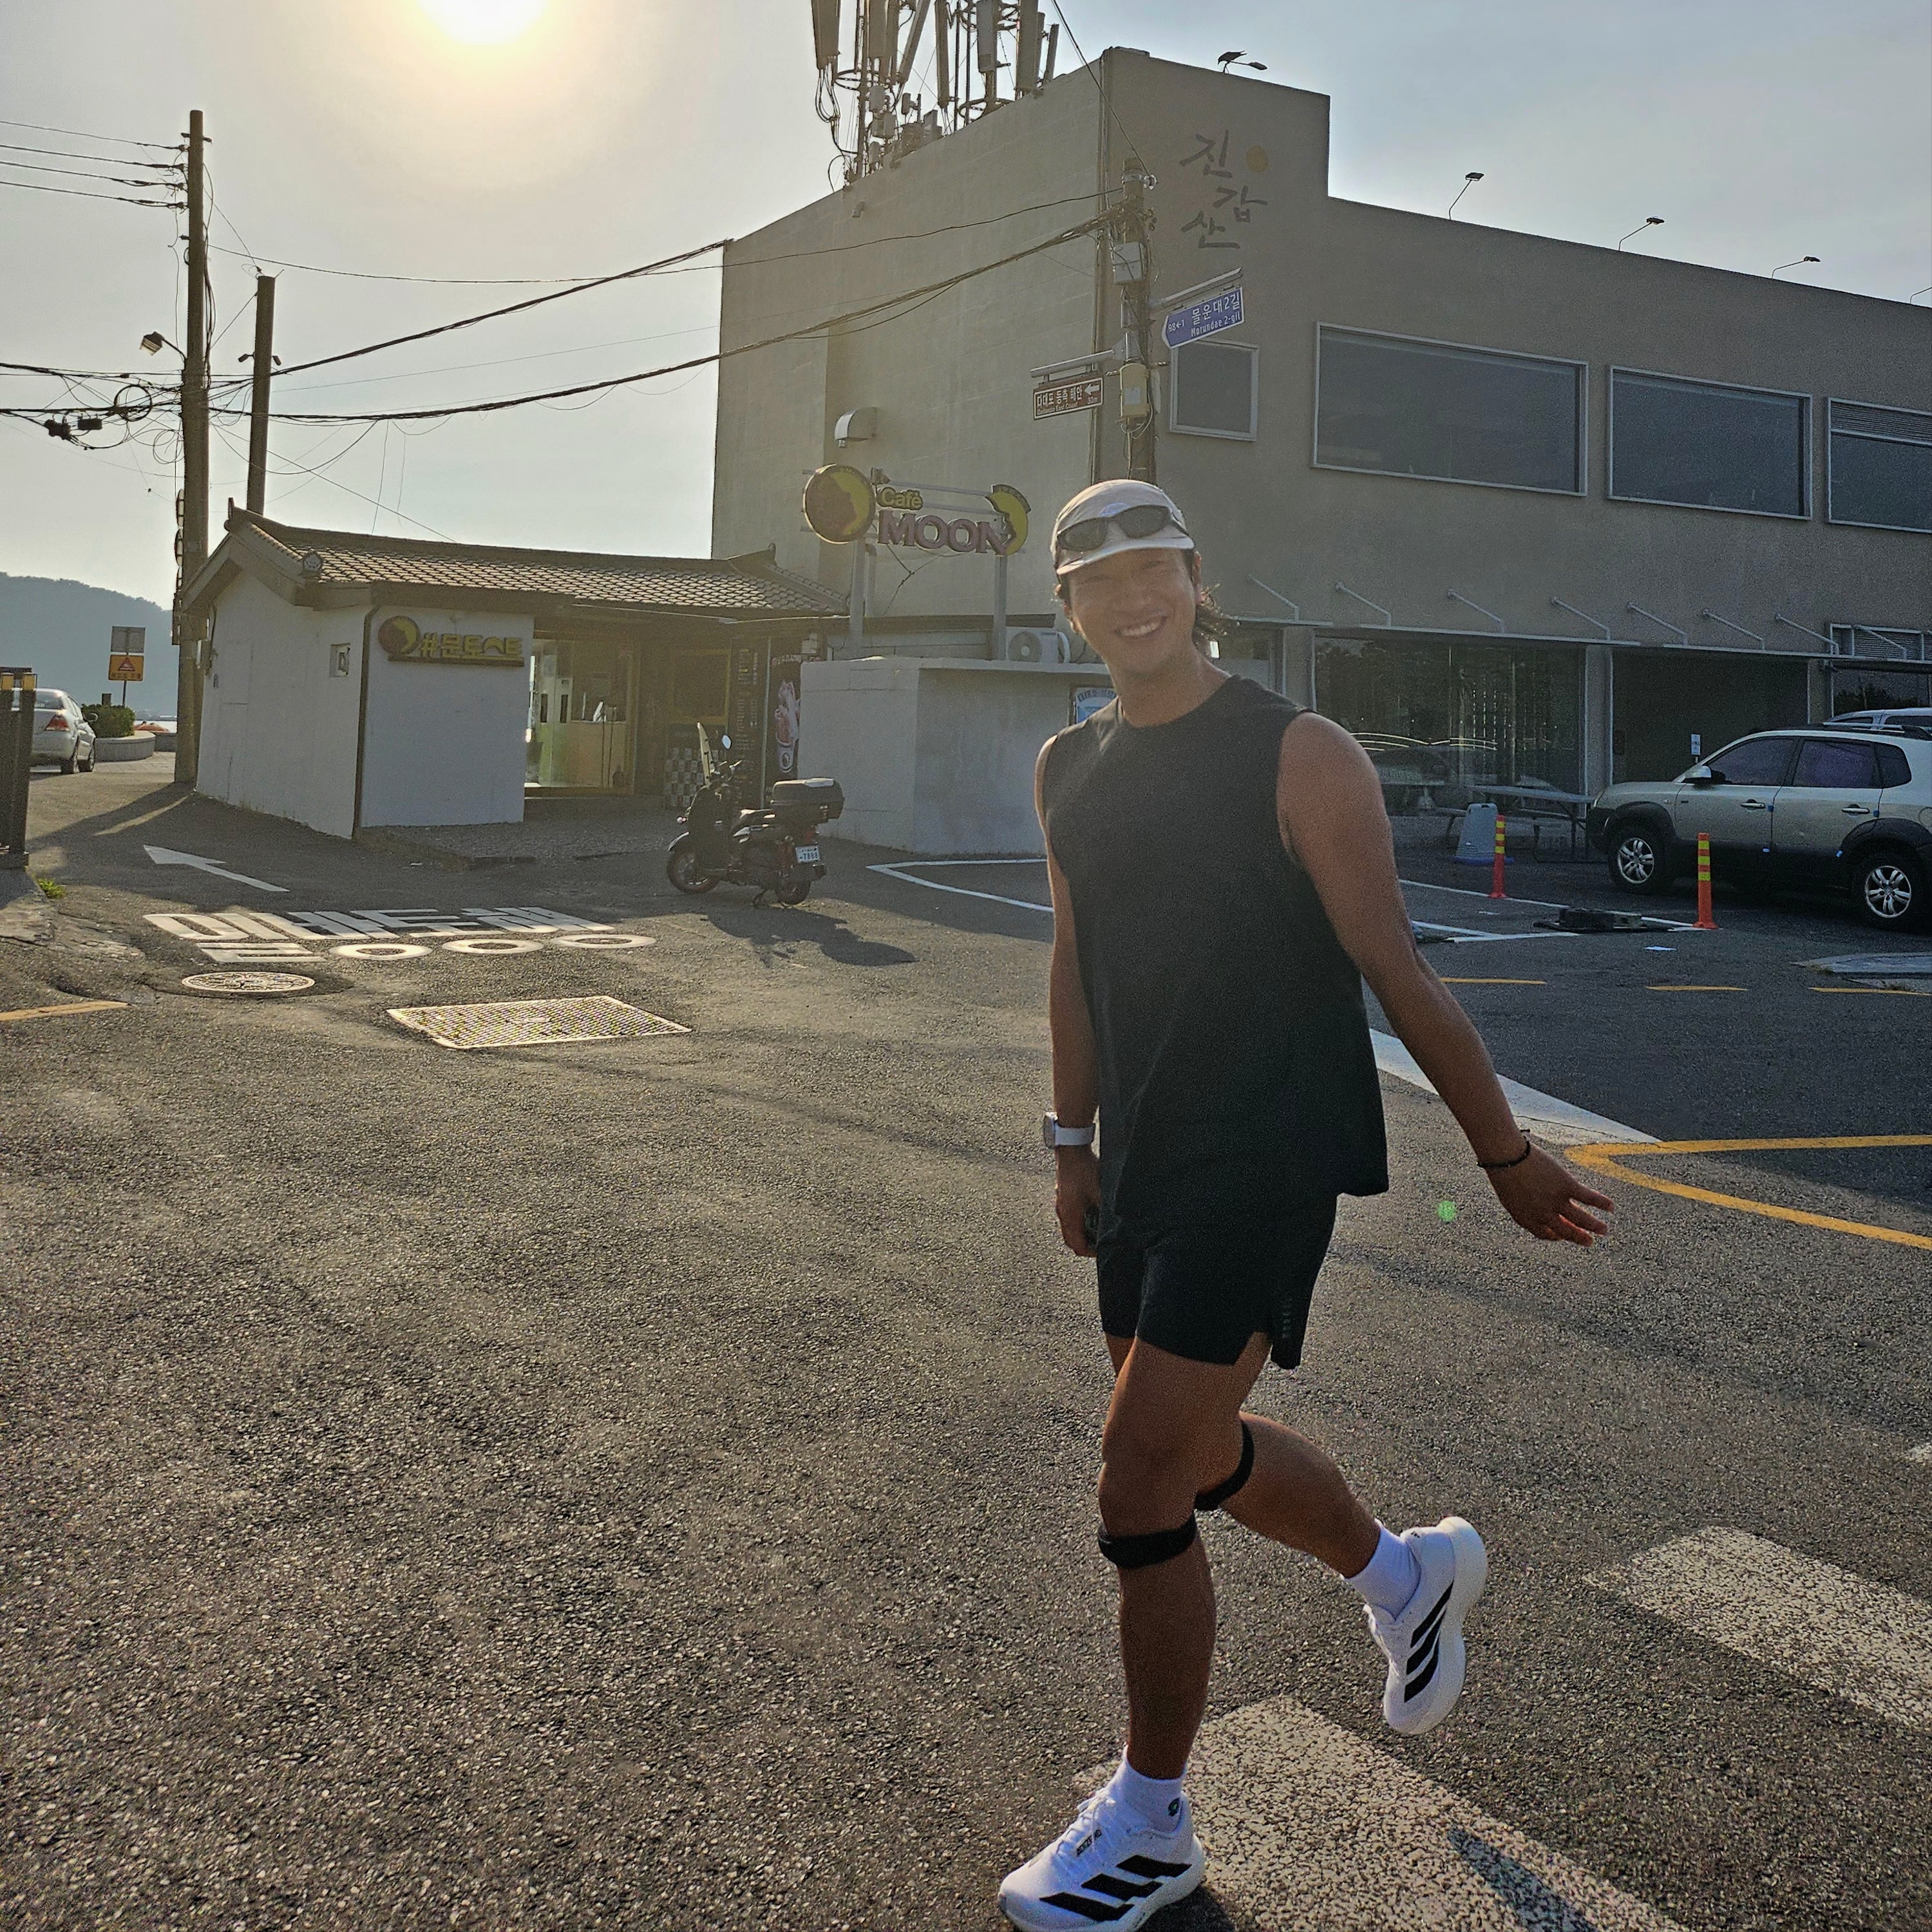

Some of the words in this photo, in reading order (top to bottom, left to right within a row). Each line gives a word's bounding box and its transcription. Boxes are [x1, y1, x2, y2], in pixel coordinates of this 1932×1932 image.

[1191, 292, 1240, 326] 몰운대2길
[1191, 319, 1222, 337] Morundae
[1224, 311, 1240, 325] 2-gil
[1037, 392, 1054, 408] 다대포
[1070, 385, 1083, 401] 해안
[877, 511, 1007, 555] MOON
